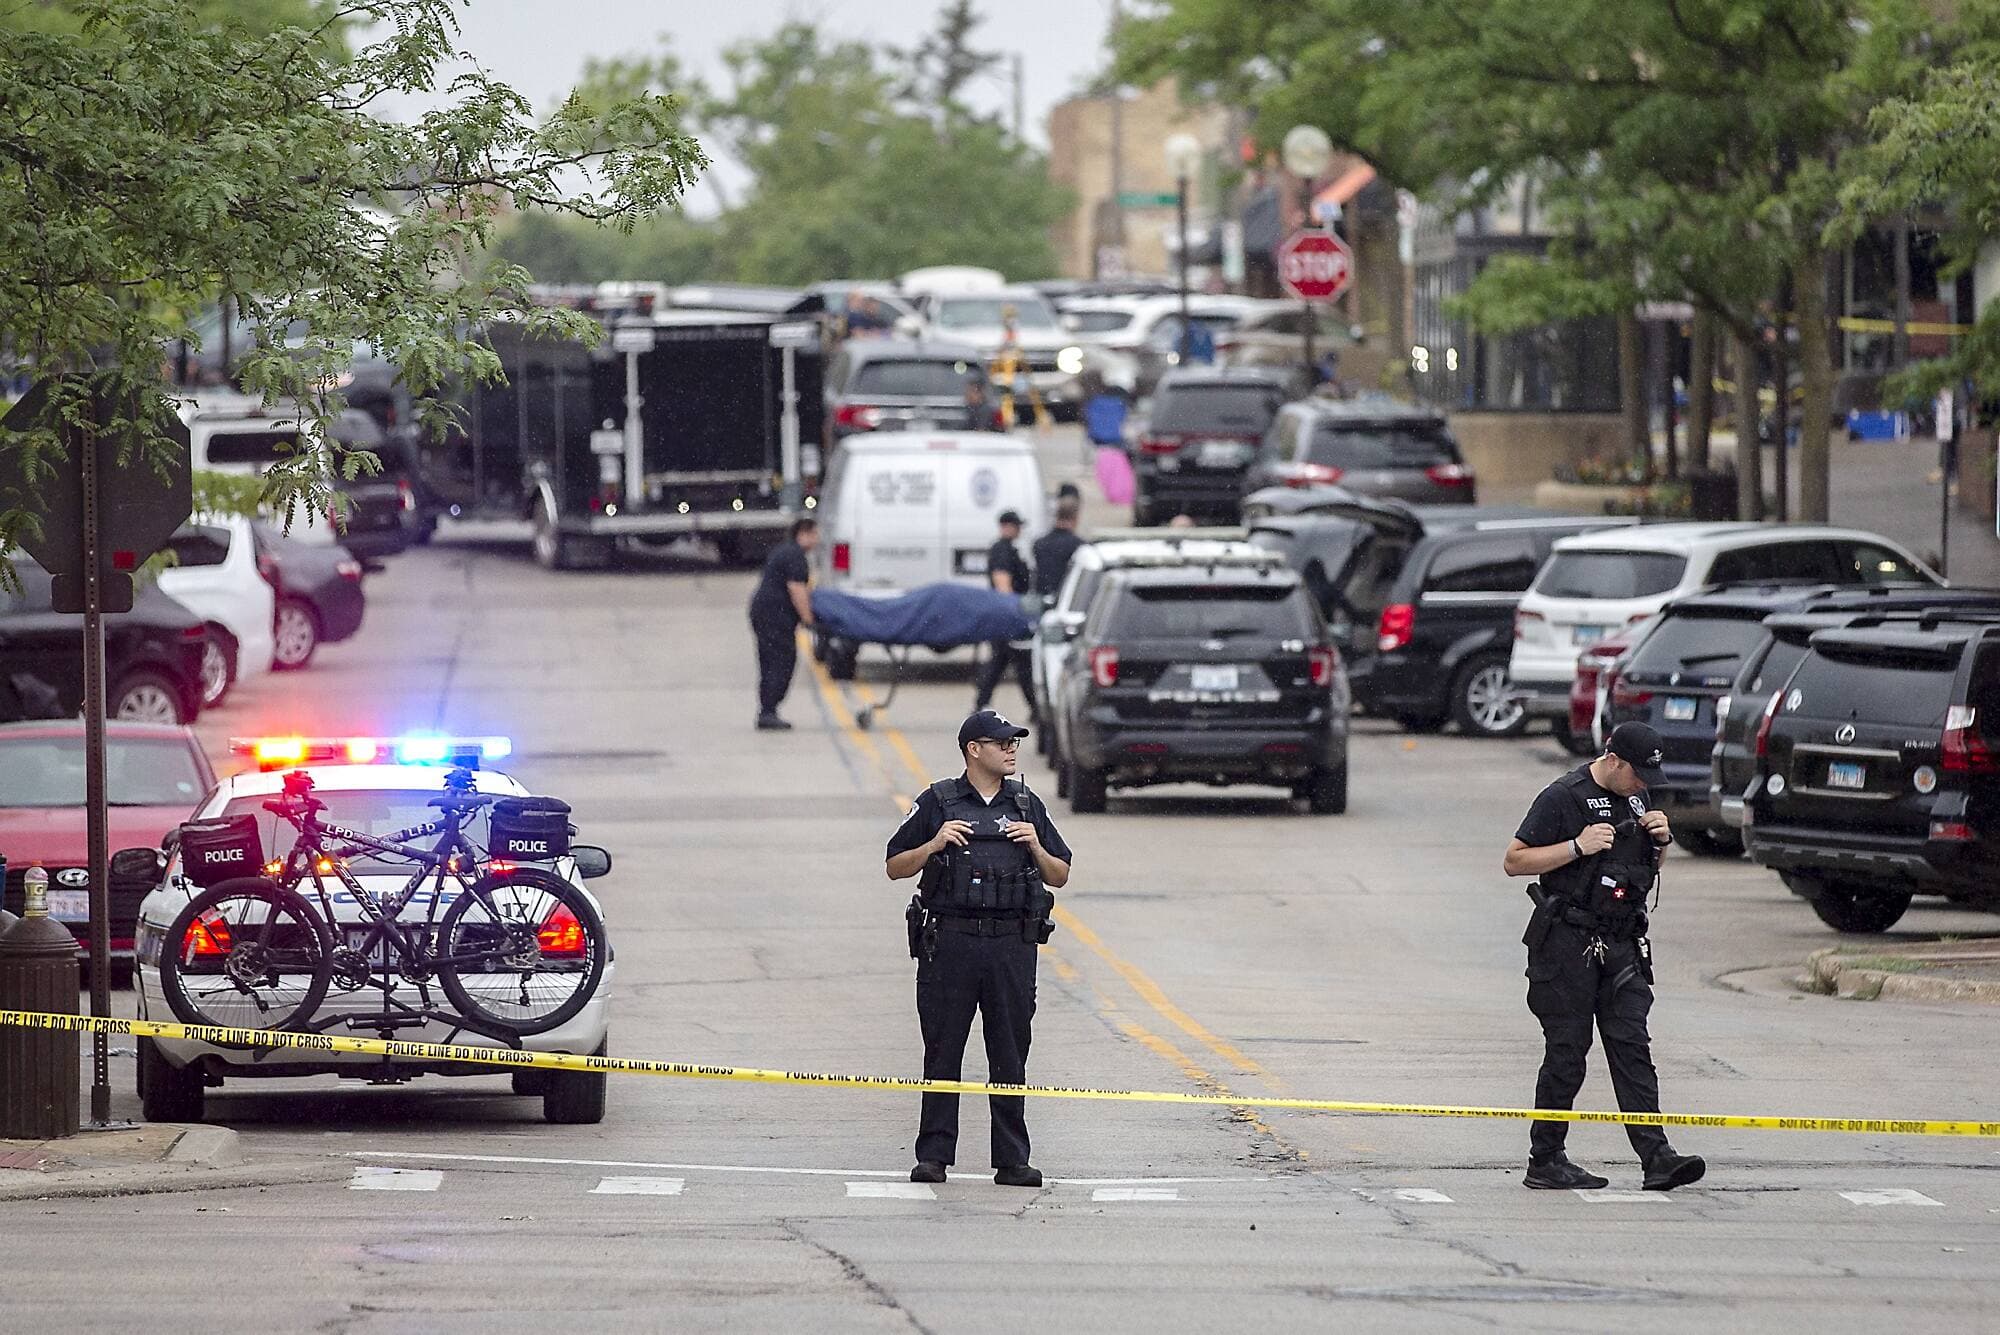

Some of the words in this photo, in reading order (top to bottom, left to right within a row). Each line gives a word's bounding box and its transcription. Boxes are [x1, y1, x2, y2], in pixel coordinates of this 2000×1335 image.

[1286, 251, 1343, 283] STOP
[1587, 798, 1612, 809] POLICE
[326, 824, 354, 839] LPD
[509, 840, 547, 852] POLICE
[205, 849, 244, 863] POLICE
[35, 884, 44, 895] G
[502, 903, 529, 917] 17
[2, 1013, 20, 1025] ICE
[23, 1014, 47, 1027] LINE
[51, 1016, 66, 1030] DO
[70, 1017, 92, 1031] NOT
[94, 1019, 131, 1034] CROSS
[184, 1026, 223, 1041] POLICE
[226, 1030, 250, 1043] LINE
[253, 1032, 269, 1045] DO
[272, 1034, 294, 1046] NOT
[297, 1036, 333, 1049] CROSS
[386, 1042, 424, 1056] POLICE
[428, 1045, 451, 1058] LINE
[455, 1048, 470, 1059] DO
[473, 1049, 495, 1061] NOT
[500, 1050, 534, 1063] CROSS
[586, 1057, 624, 1069] POLICE
[629, 1062, 651, 1070] LINE
[655, 1063, 670, 1072] DO
